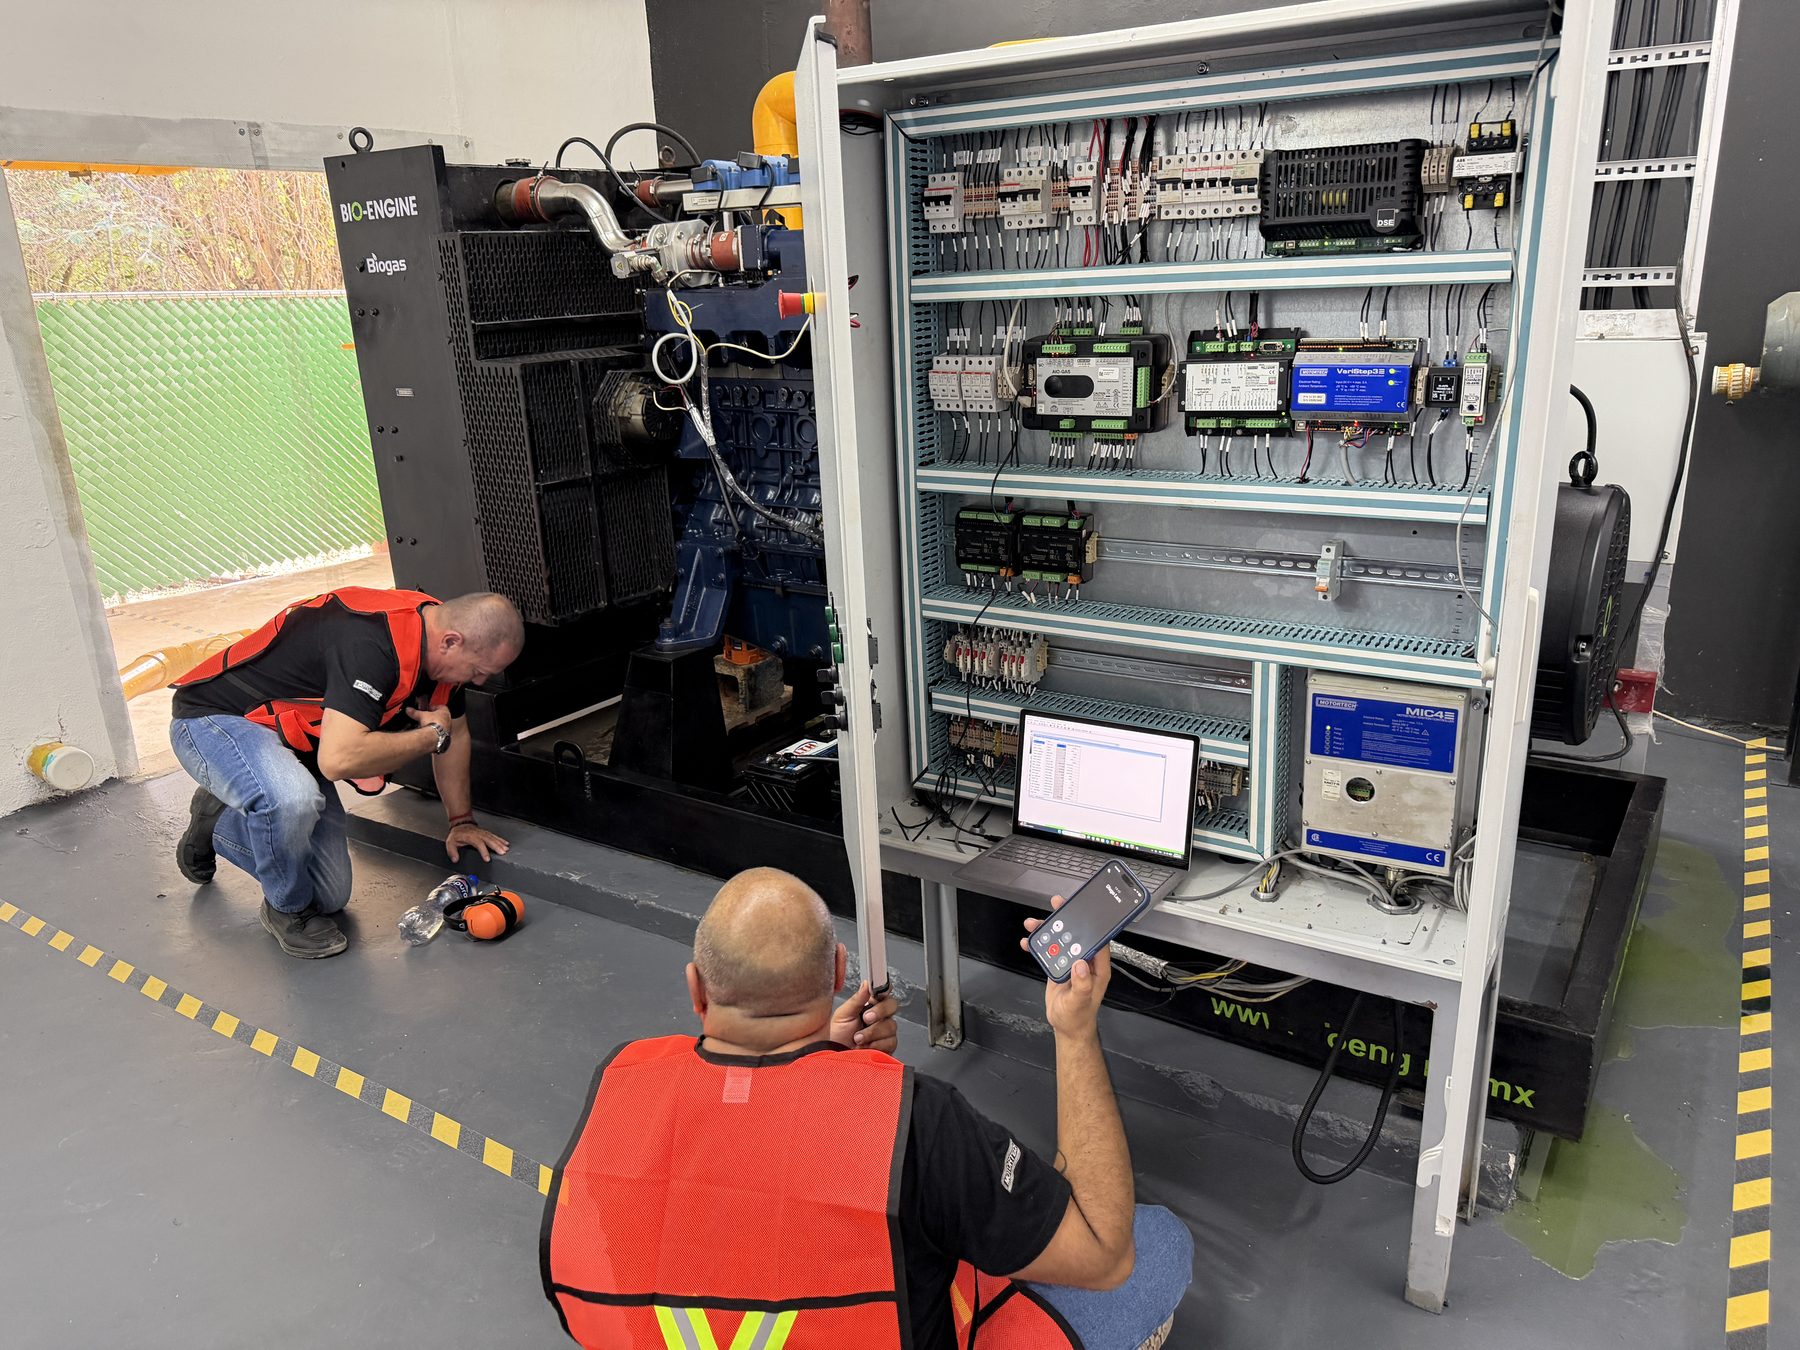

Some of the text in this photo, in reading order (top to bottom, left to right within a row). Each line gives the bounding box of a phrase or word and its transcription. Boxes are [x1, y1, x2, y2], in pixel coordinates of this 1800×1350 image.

[340, 195, 418, 223] BIO-ENGINE
[1377, 219, 1395, 227] DSE
[366, 254, 407, 275] Biogas
